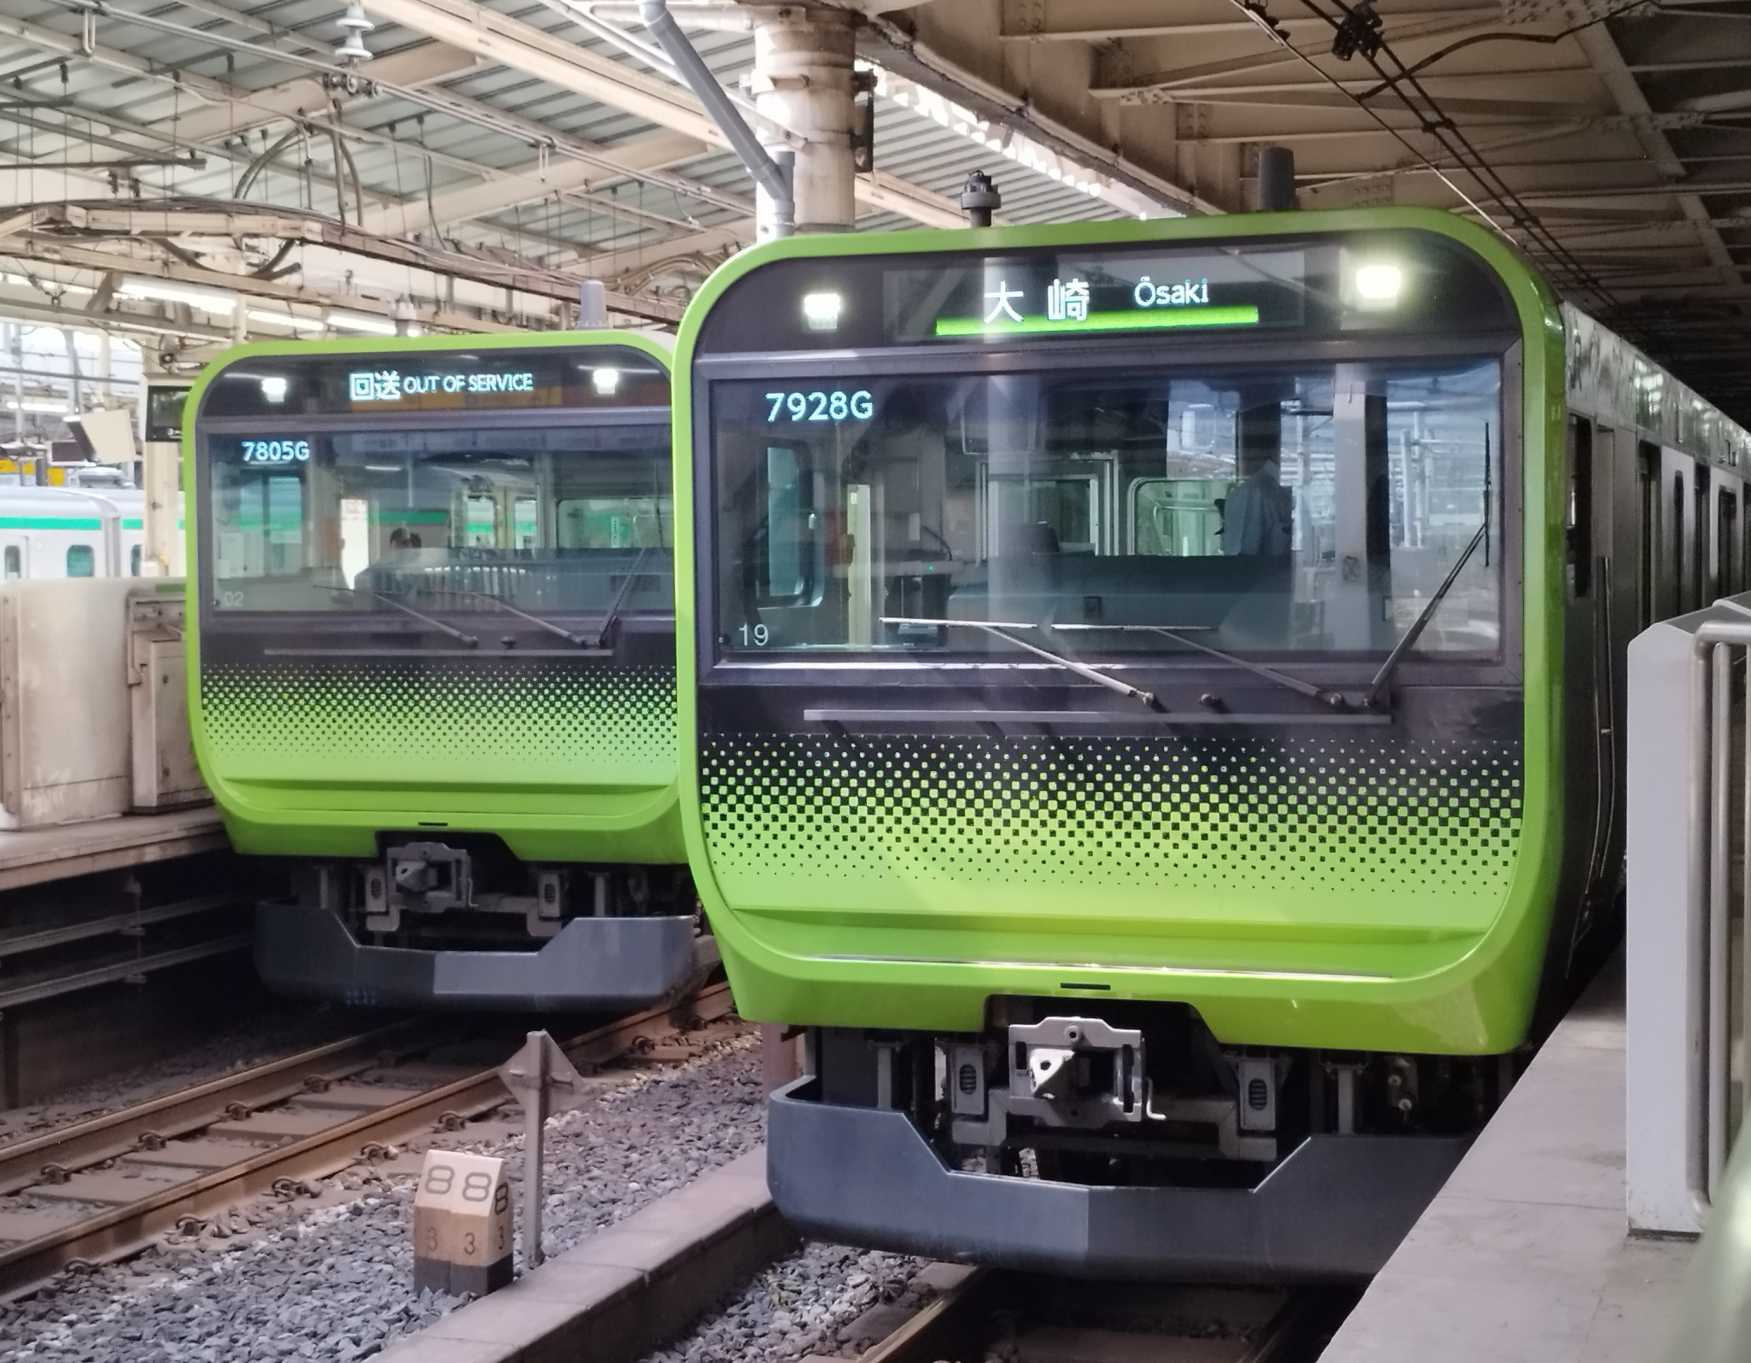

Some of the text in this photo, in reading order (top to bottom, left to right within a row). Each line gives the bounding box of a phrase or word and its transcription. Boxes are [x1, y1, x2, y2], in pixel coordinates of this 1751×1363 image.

[984, 278, 1090, 324] 大崎
[1134, 276, 1209, 307] Ōsaki
[350, 370, 401, 401] 回送
[403, 372, 534, 394] OUT OF SERVICE
[765, 390, 873, 422] 7928G
[241, 441, 310, 462] 7805G
[224, 591, 244, 607] 02
[739, 623, 769, 646] 19
